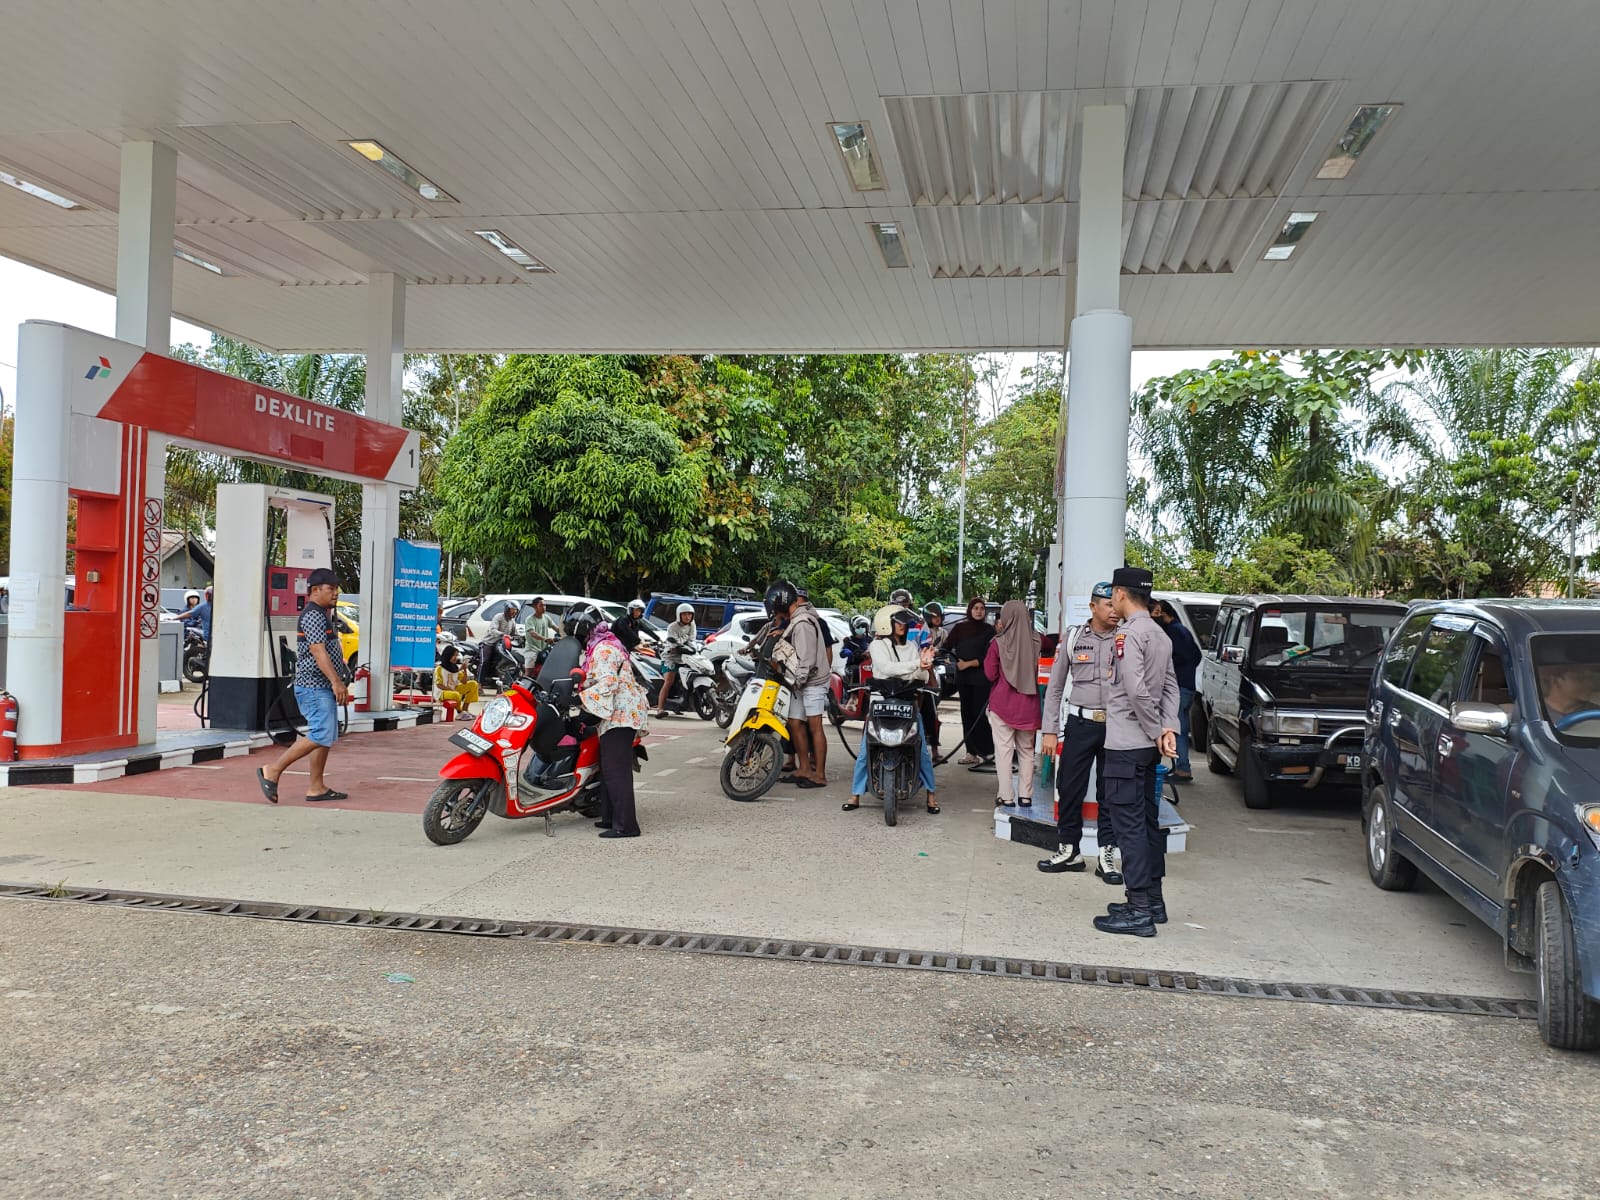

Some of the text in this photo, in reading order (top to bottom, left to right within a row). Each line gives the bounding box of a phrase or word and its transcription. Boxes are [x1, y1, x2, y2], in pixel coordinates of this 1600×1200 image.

[256, 393, 335, 432] DEXLITE
[408, 449, 414, 468] 1
[395, 579, 438, 590] PERTAMAX
[1346, 755, 1361, 767] KB
